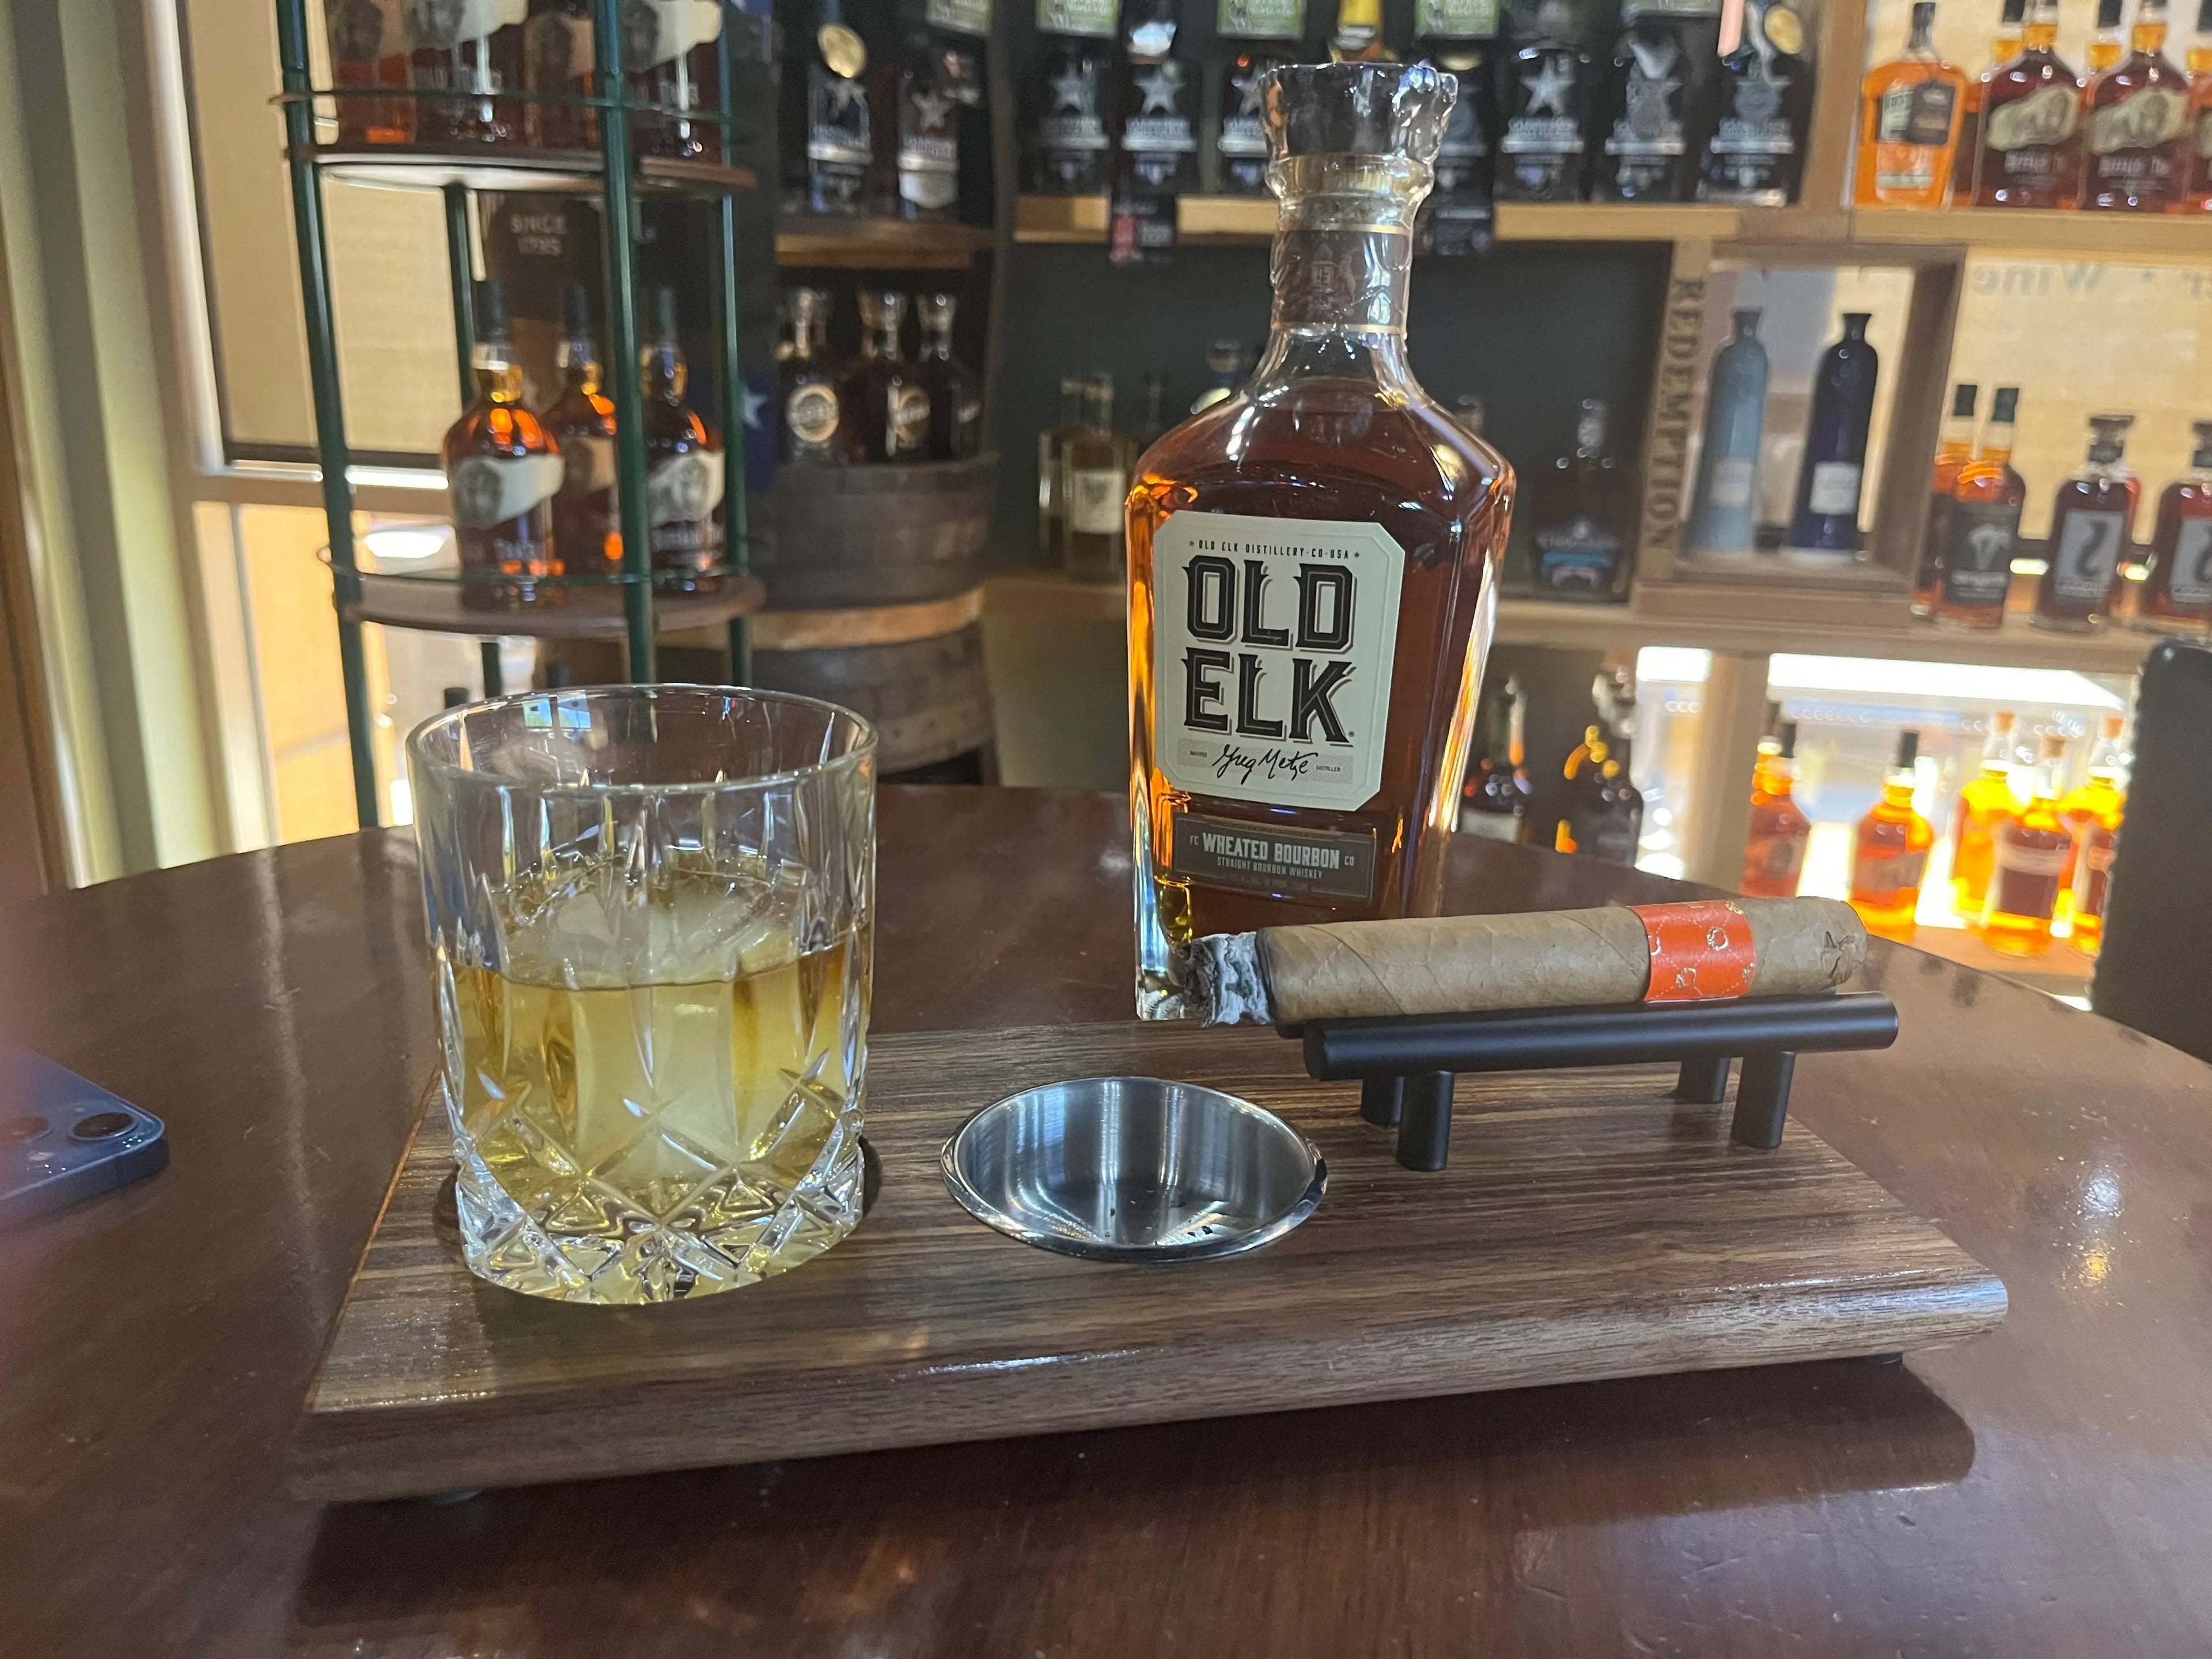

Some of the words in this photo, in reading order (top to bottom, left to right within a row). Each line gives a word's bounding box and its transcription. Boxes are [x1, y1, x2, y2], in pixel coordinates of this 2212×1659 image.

[1646, 280, 1704, 547] REDEMPTION
[1199, 540, 1215, 550] OLD
[1222, 541, 1238, 552] ELK
[1181, 555, 1357, 654] OLD
[1181, 647, 1356, 747] ELK
[1203, 832, 1268, 860] WHEATED
[1274, 843, 1340, 869] BOURBON
[1344, 856, 1354, 866] CO
[1217, 857, 1251, 871] STRAIGHT
[1253, 862, 1286, 875] BOURBON
[1289, 868, 1323, 880] WHISKEY
